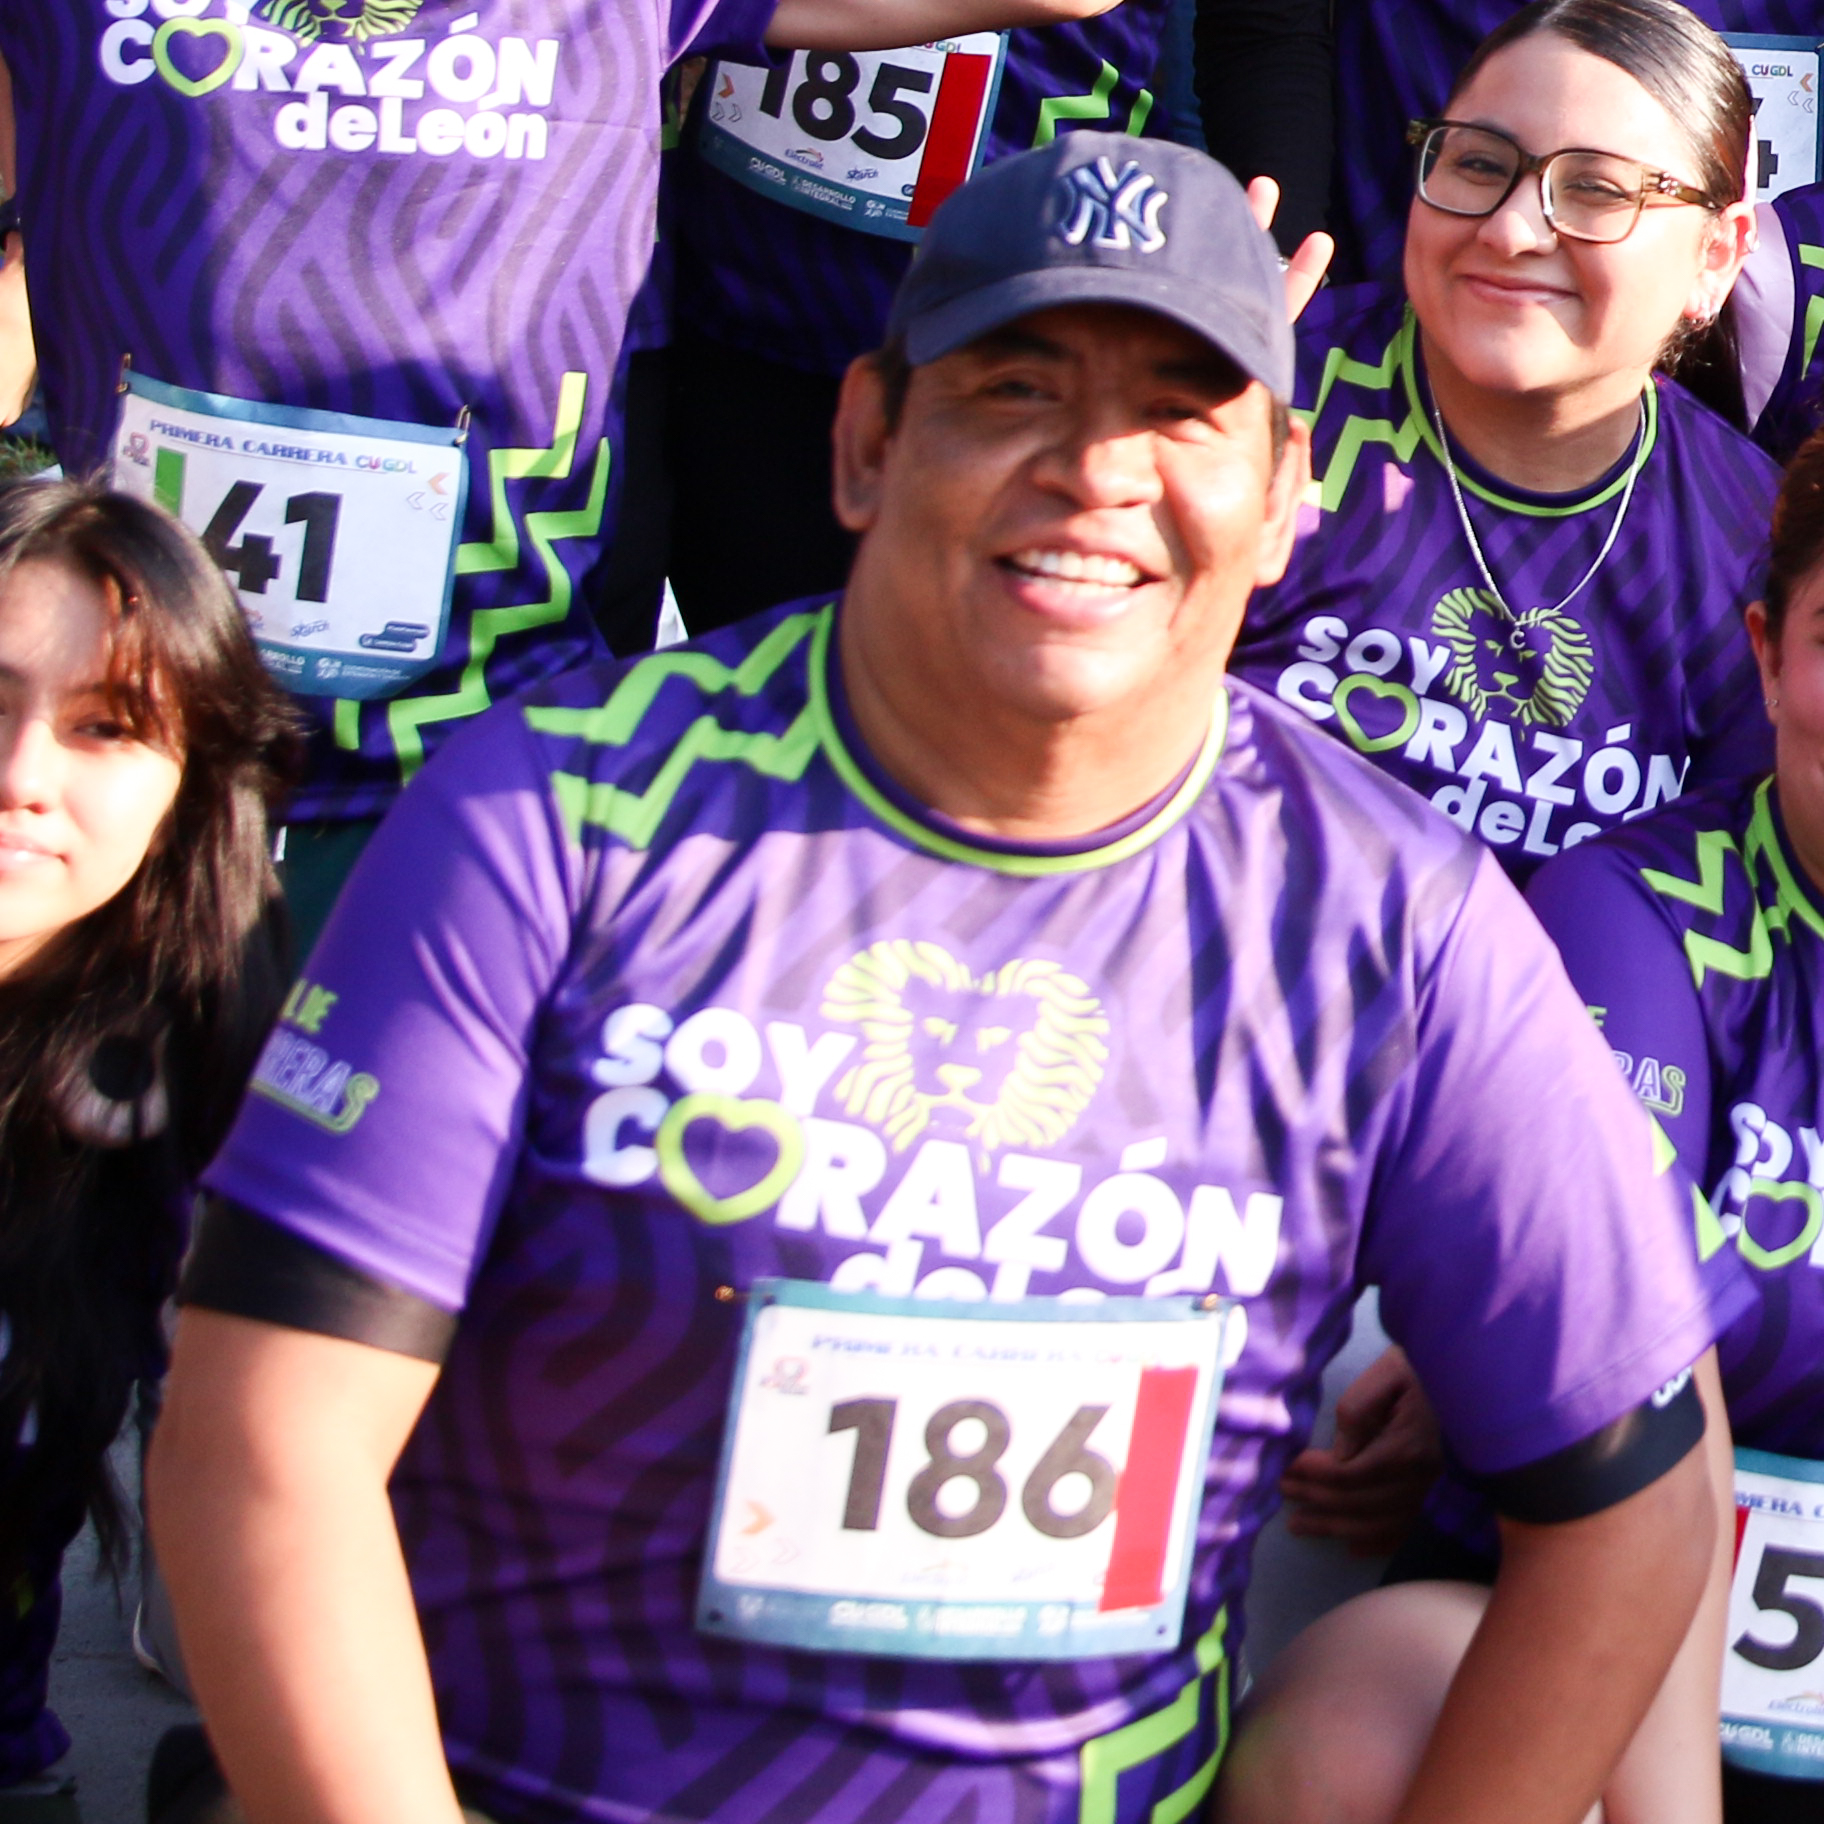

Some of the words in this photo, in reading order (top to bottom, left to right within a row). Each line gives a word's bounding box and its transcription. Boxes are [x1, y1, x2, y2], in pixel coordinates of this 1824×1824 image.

[760, 49, 934, 160] 185
[1752, 64, 1793, 77] CUGDL
[273, 91, 548, 160] deLeón
[1060, 156, 1168, 254] NY
[200, 479, 344, 604] 41
[1297, 615, 1451, 696] SOY
[593, 1002, 855, 1119] SOY
[826, 1397, 1117, 1540] 186
